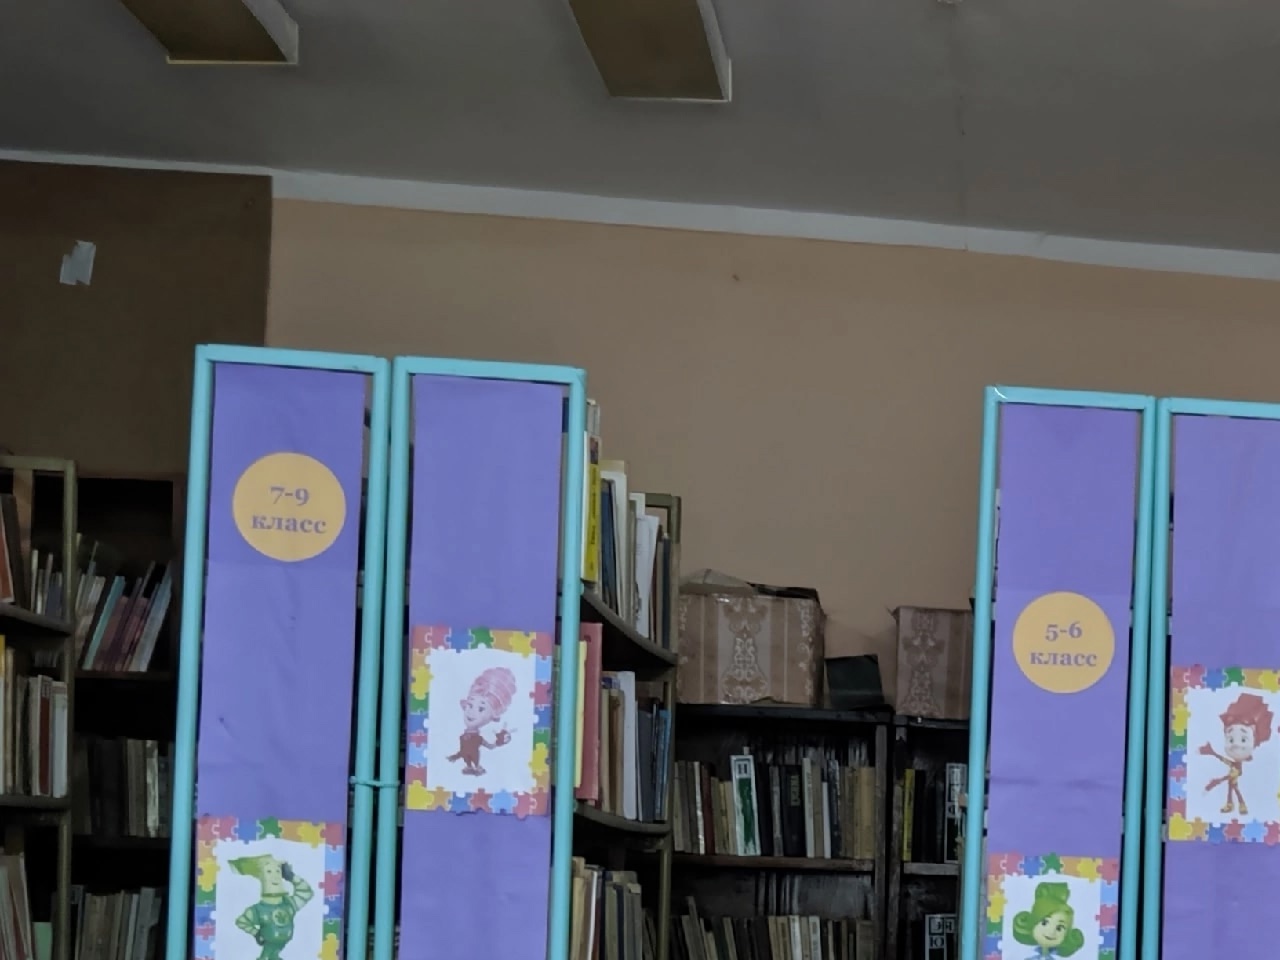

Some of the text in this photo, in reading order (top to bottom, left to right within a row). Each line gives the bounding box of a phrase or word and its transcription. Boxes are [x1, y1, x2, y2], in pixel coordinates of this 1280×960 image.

[270, 486, 310, 506] 7-9
[251, 515, 327, 534] класс
[1045, 621, 1082, 642] 5-6
[1030, 652, 1097, 667] класс
